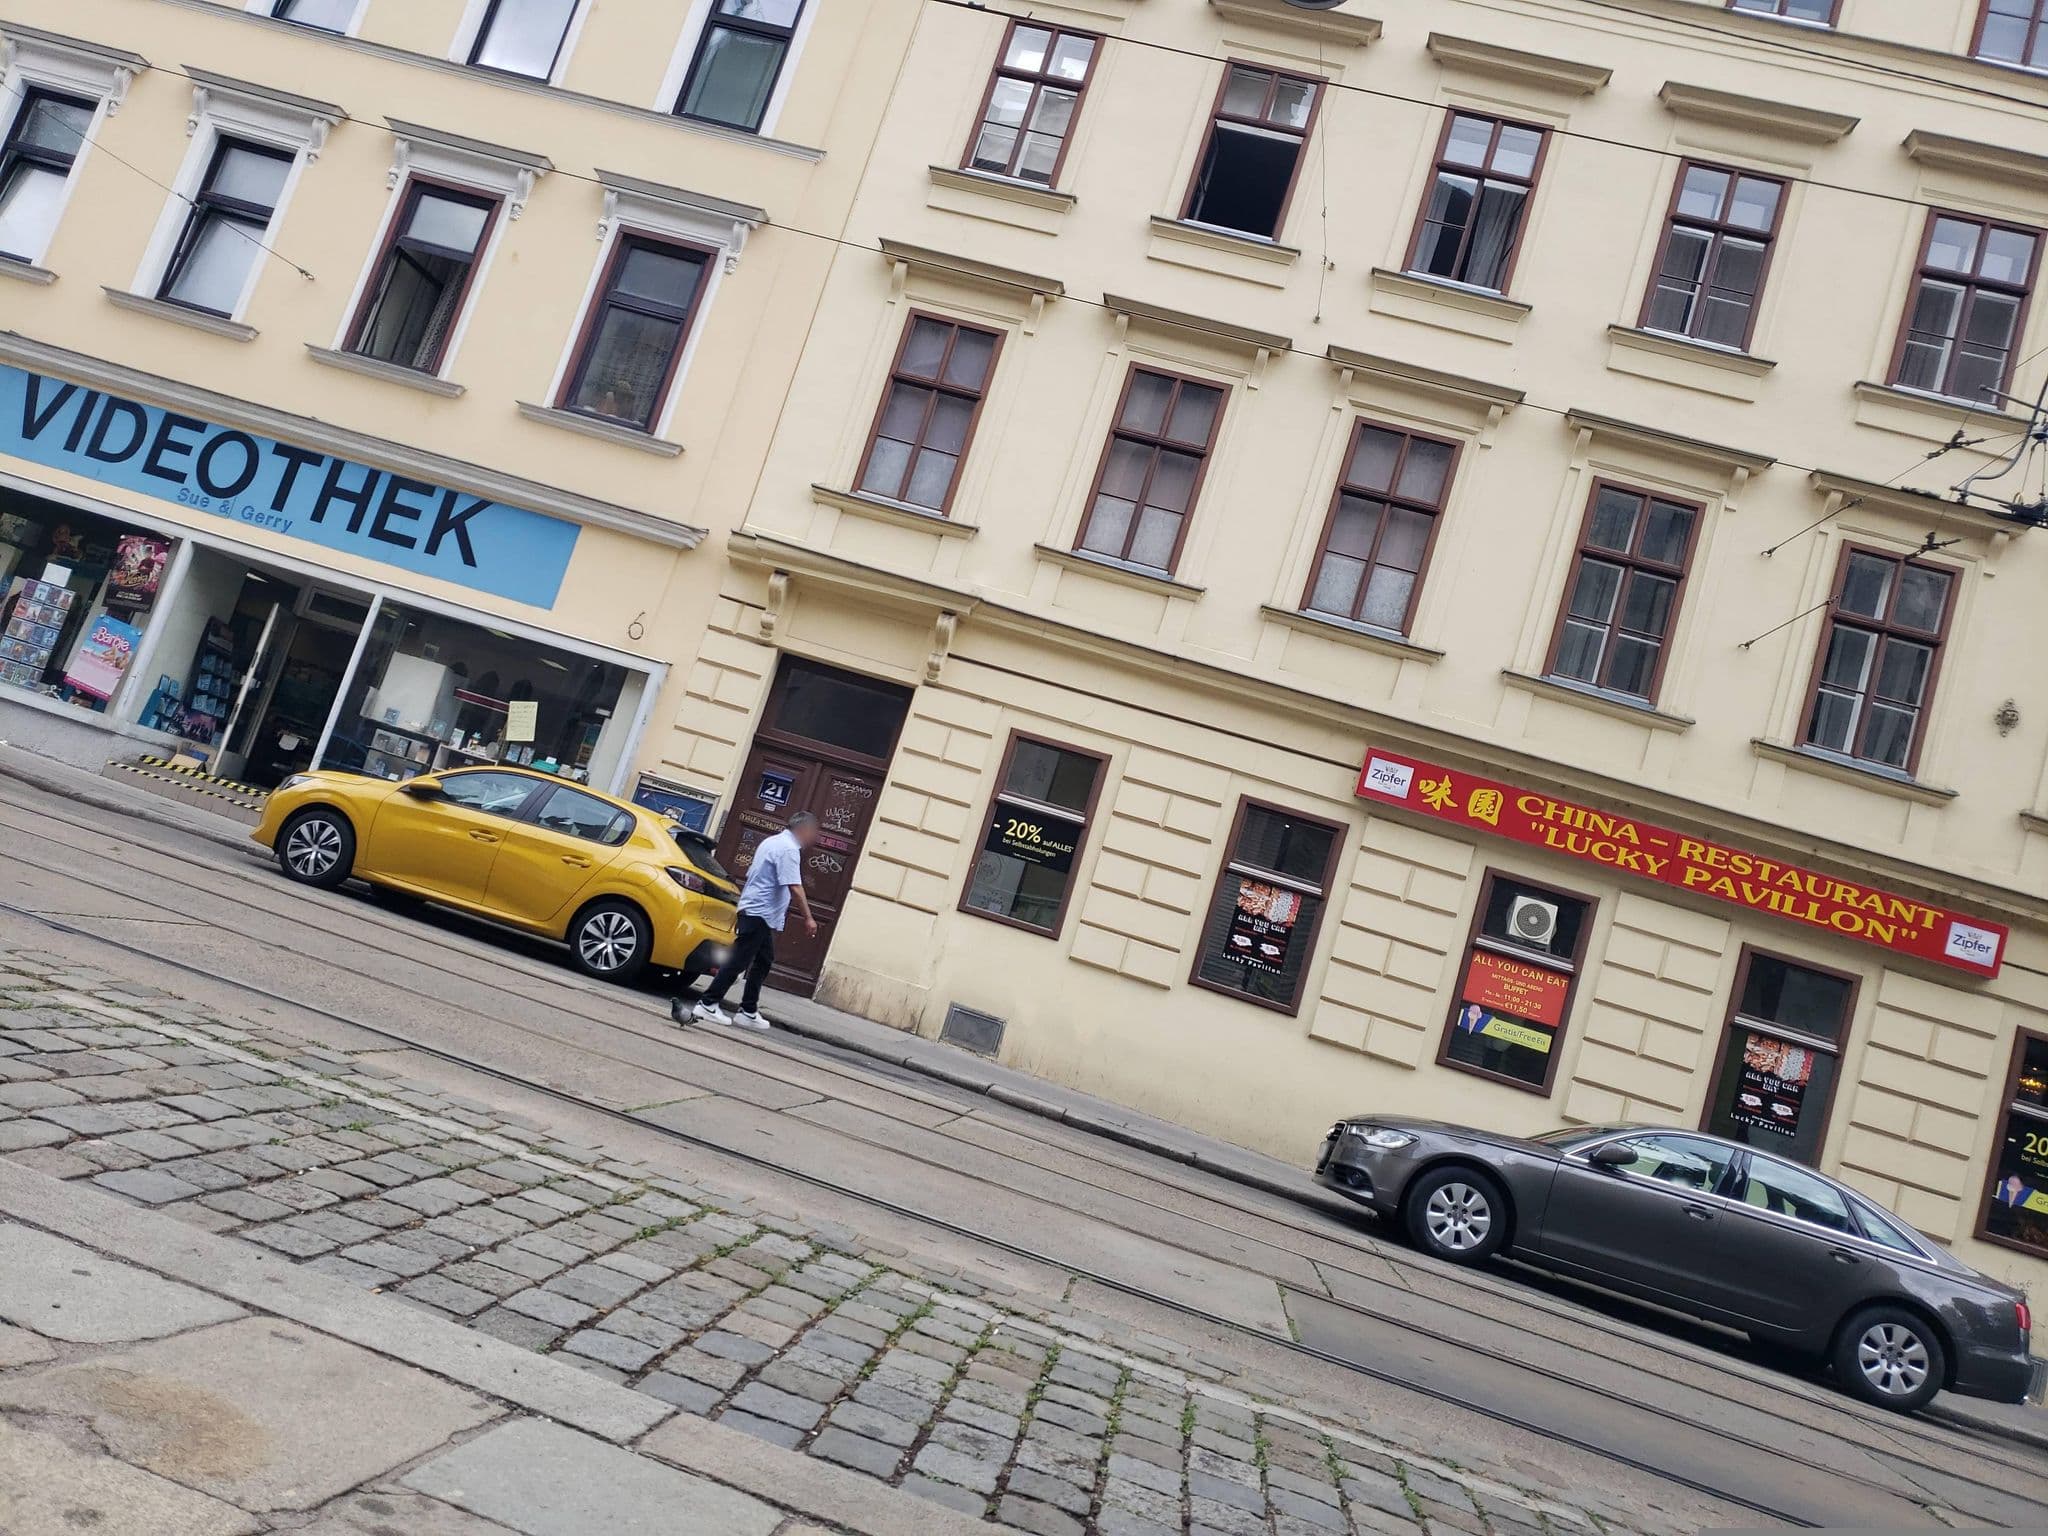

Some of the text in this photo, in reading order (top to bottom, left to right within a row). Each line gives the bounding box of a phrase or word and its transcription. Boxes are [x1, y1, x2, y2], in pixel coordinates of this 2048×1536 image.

[22, 374, 494, 568] VIDEOTHEK
[177, 487, 293, 533] Sue & Gerry
[92, 626, 130, 652] Barbie
[1371, 767, 1407, 787] Zipfer
[764, 782, 785, 798] 21
[1005, 819, 1043, 843] 20%
[1517, 796, 1641, 845] CHINA
[1677, 839, 1944, 929] RESTAURANT
[1952, 934, 1992, 956] Zipfer
[1222, 952, 1245, 964] Lucky
[1248, 960, 1281, 975] Pavillon
[1474, 954, 1568, 988] ALL YOU CAN EAT
[1503, 983, 1529, 996] BUFFET
[1730, 1112, 1755, 1125] Lucky
[1758, 1121, 1795, 1137] Pavillon
